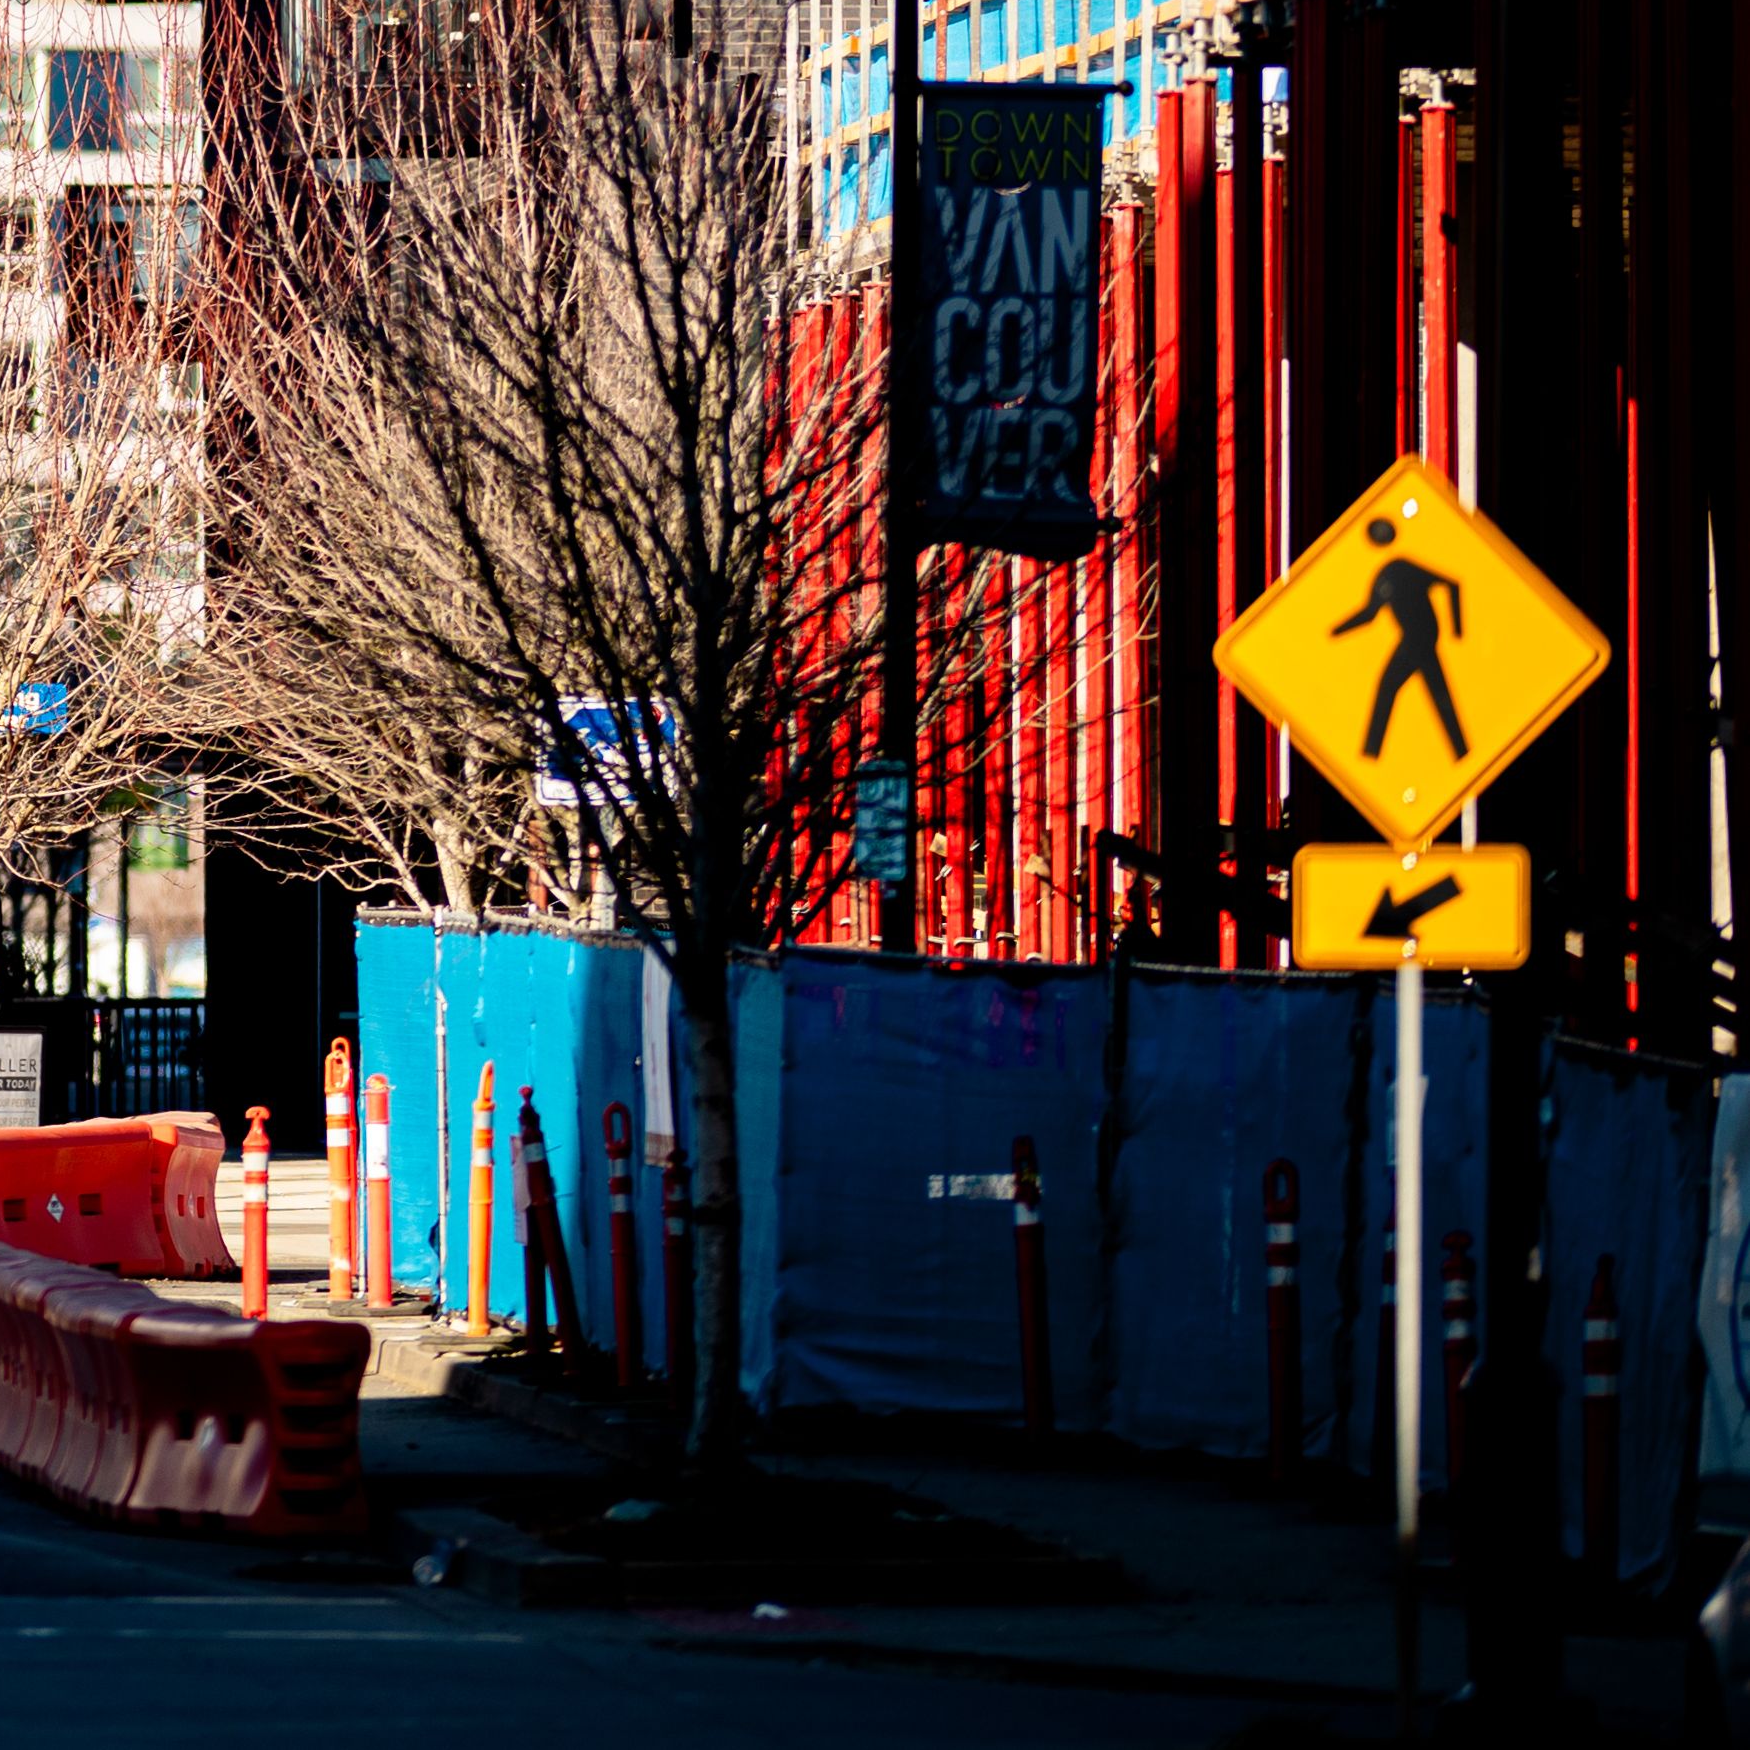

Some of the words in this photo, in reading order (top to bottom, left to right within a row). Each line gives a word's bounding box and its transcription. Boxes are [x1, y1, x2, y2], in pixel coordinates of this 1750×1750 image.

[935, 109, 1092, 144] DOWN
[935, 147, 1091, 182] TOWN
[934, 186, 1090, 295] VAN
[932, 295, 1087, 405] COU
[928, 405, 1082, 503] VER
[6, 1078, 37, 1090] TODAY
